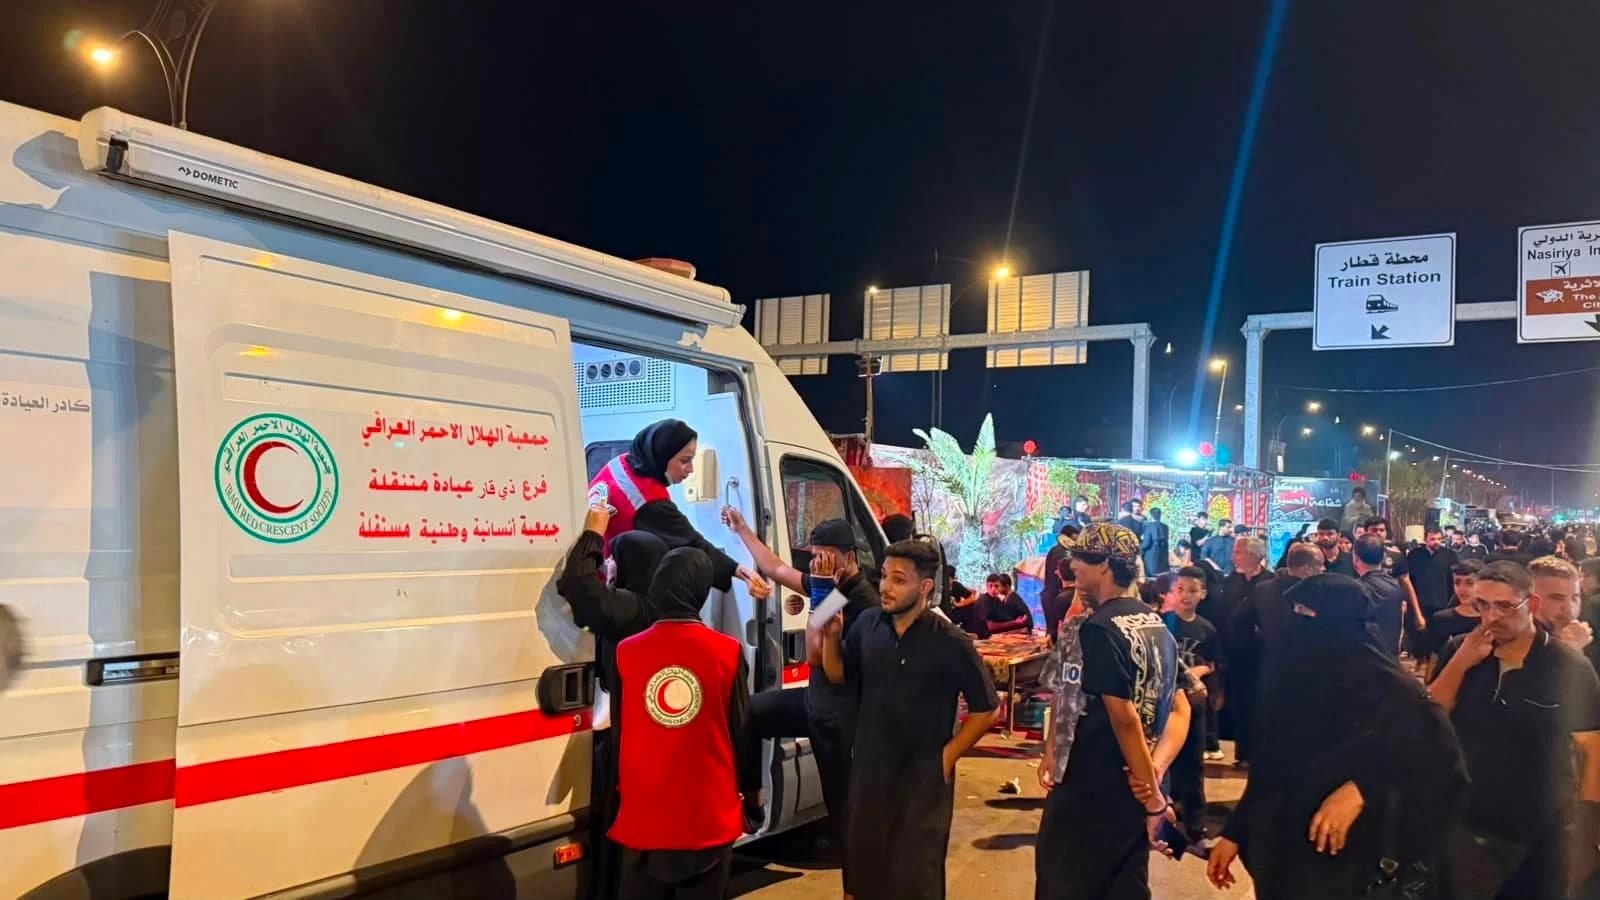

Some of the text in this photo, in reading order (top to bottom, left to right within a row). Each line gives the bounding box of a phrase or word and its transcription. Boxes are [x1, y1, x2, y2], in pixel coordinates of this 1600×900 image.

[193, 170, 239, 189] DOMETIC
[1533, 232, 1573, 248] الدولي
[1340, 252, 1429, 271] محطة قطار
[1527, 247, 1581, 260] Nasiriya
[1328, 271, 1441, 288] Train Station
[2, 392, 90, 413] كادر العيادة
[286, 422, 315, 444] الهلال
[361, 411, 549, 450] جمعية الهلال الاحمر العراقي
[313, 441, 331, 474] جمعية
[368, 468, 547, 500] فرع ذي قار عيادة متنقلة
[224, 483, 333, 536] IRAQI RED CRESCENT SOCIETY
[358, 512, 411, 538] مستقلة
[419, 518, 468, 544] وطنية
[520, 515, 560, 544] جمعية
